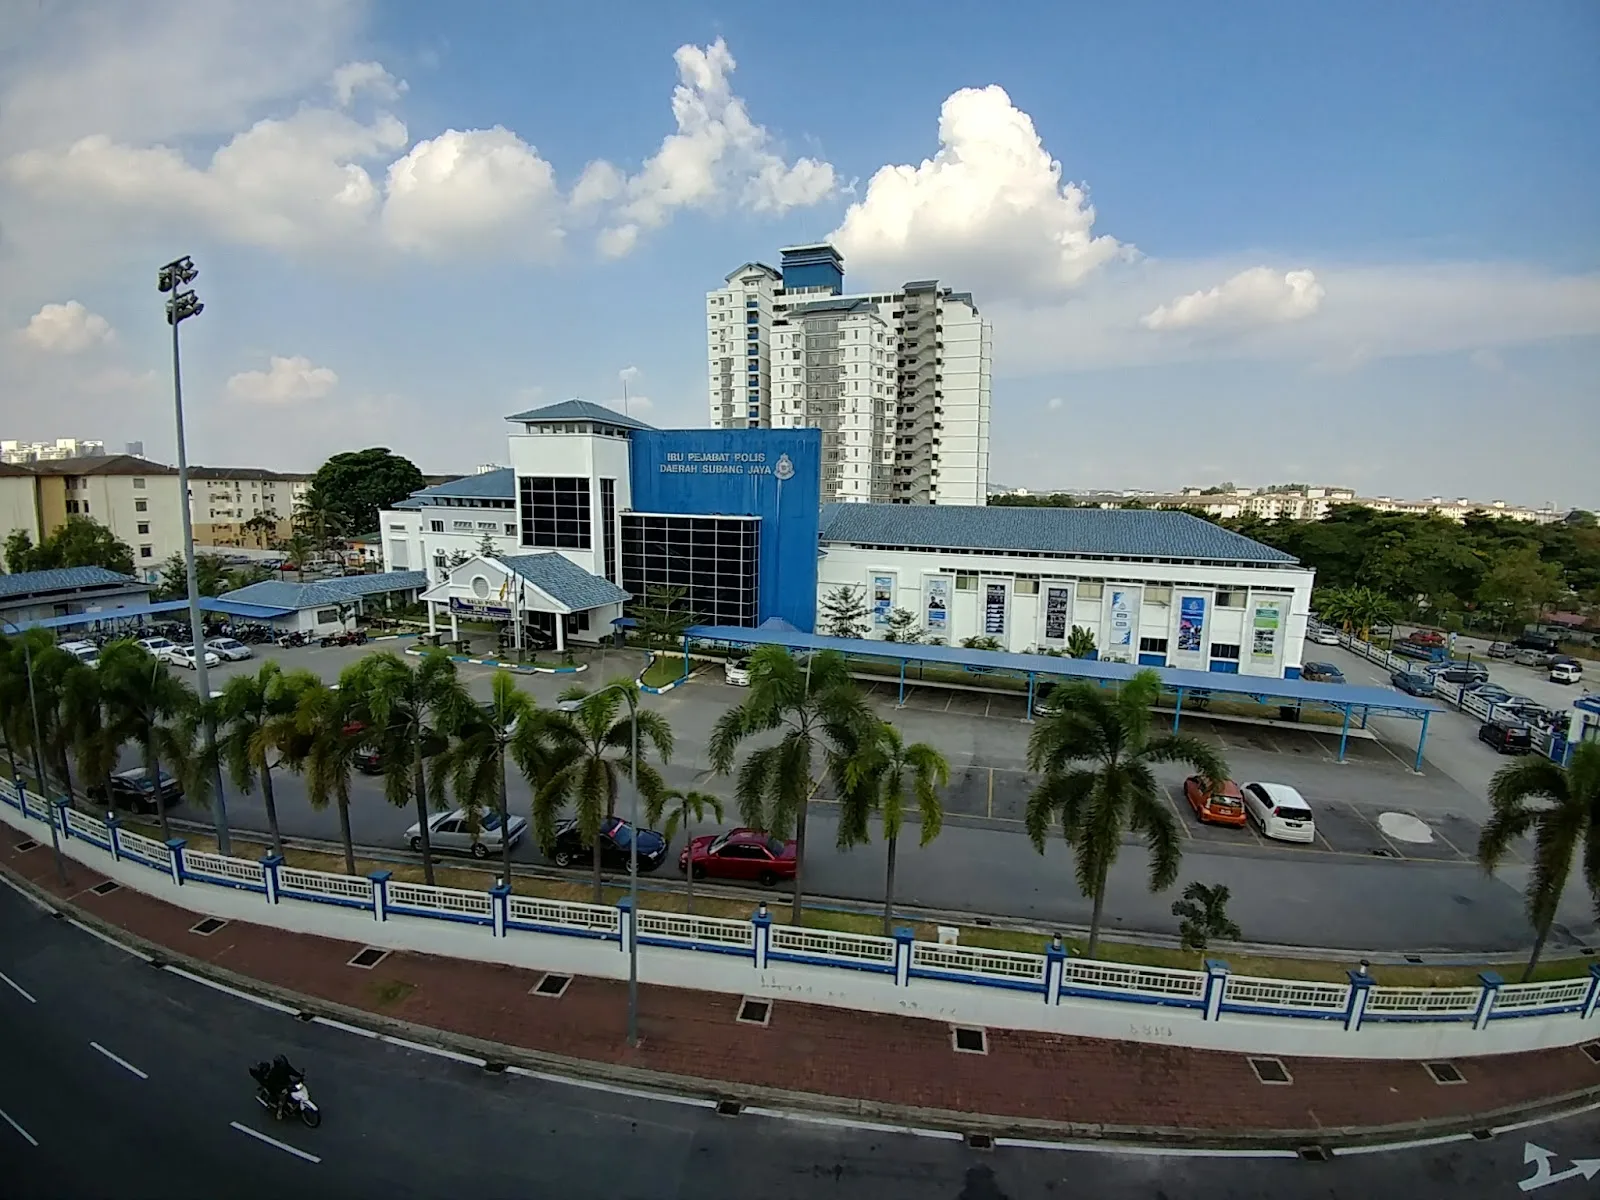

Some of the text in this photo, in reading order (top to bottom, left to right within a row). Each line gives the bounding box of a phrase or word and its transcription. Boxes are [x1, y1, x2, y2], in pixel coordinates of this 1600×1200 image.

[667, 453, 766, 463] IBU PEJABAT POLIS
[660, 464, 772, 475] DAERAH SUBANG JAYA
